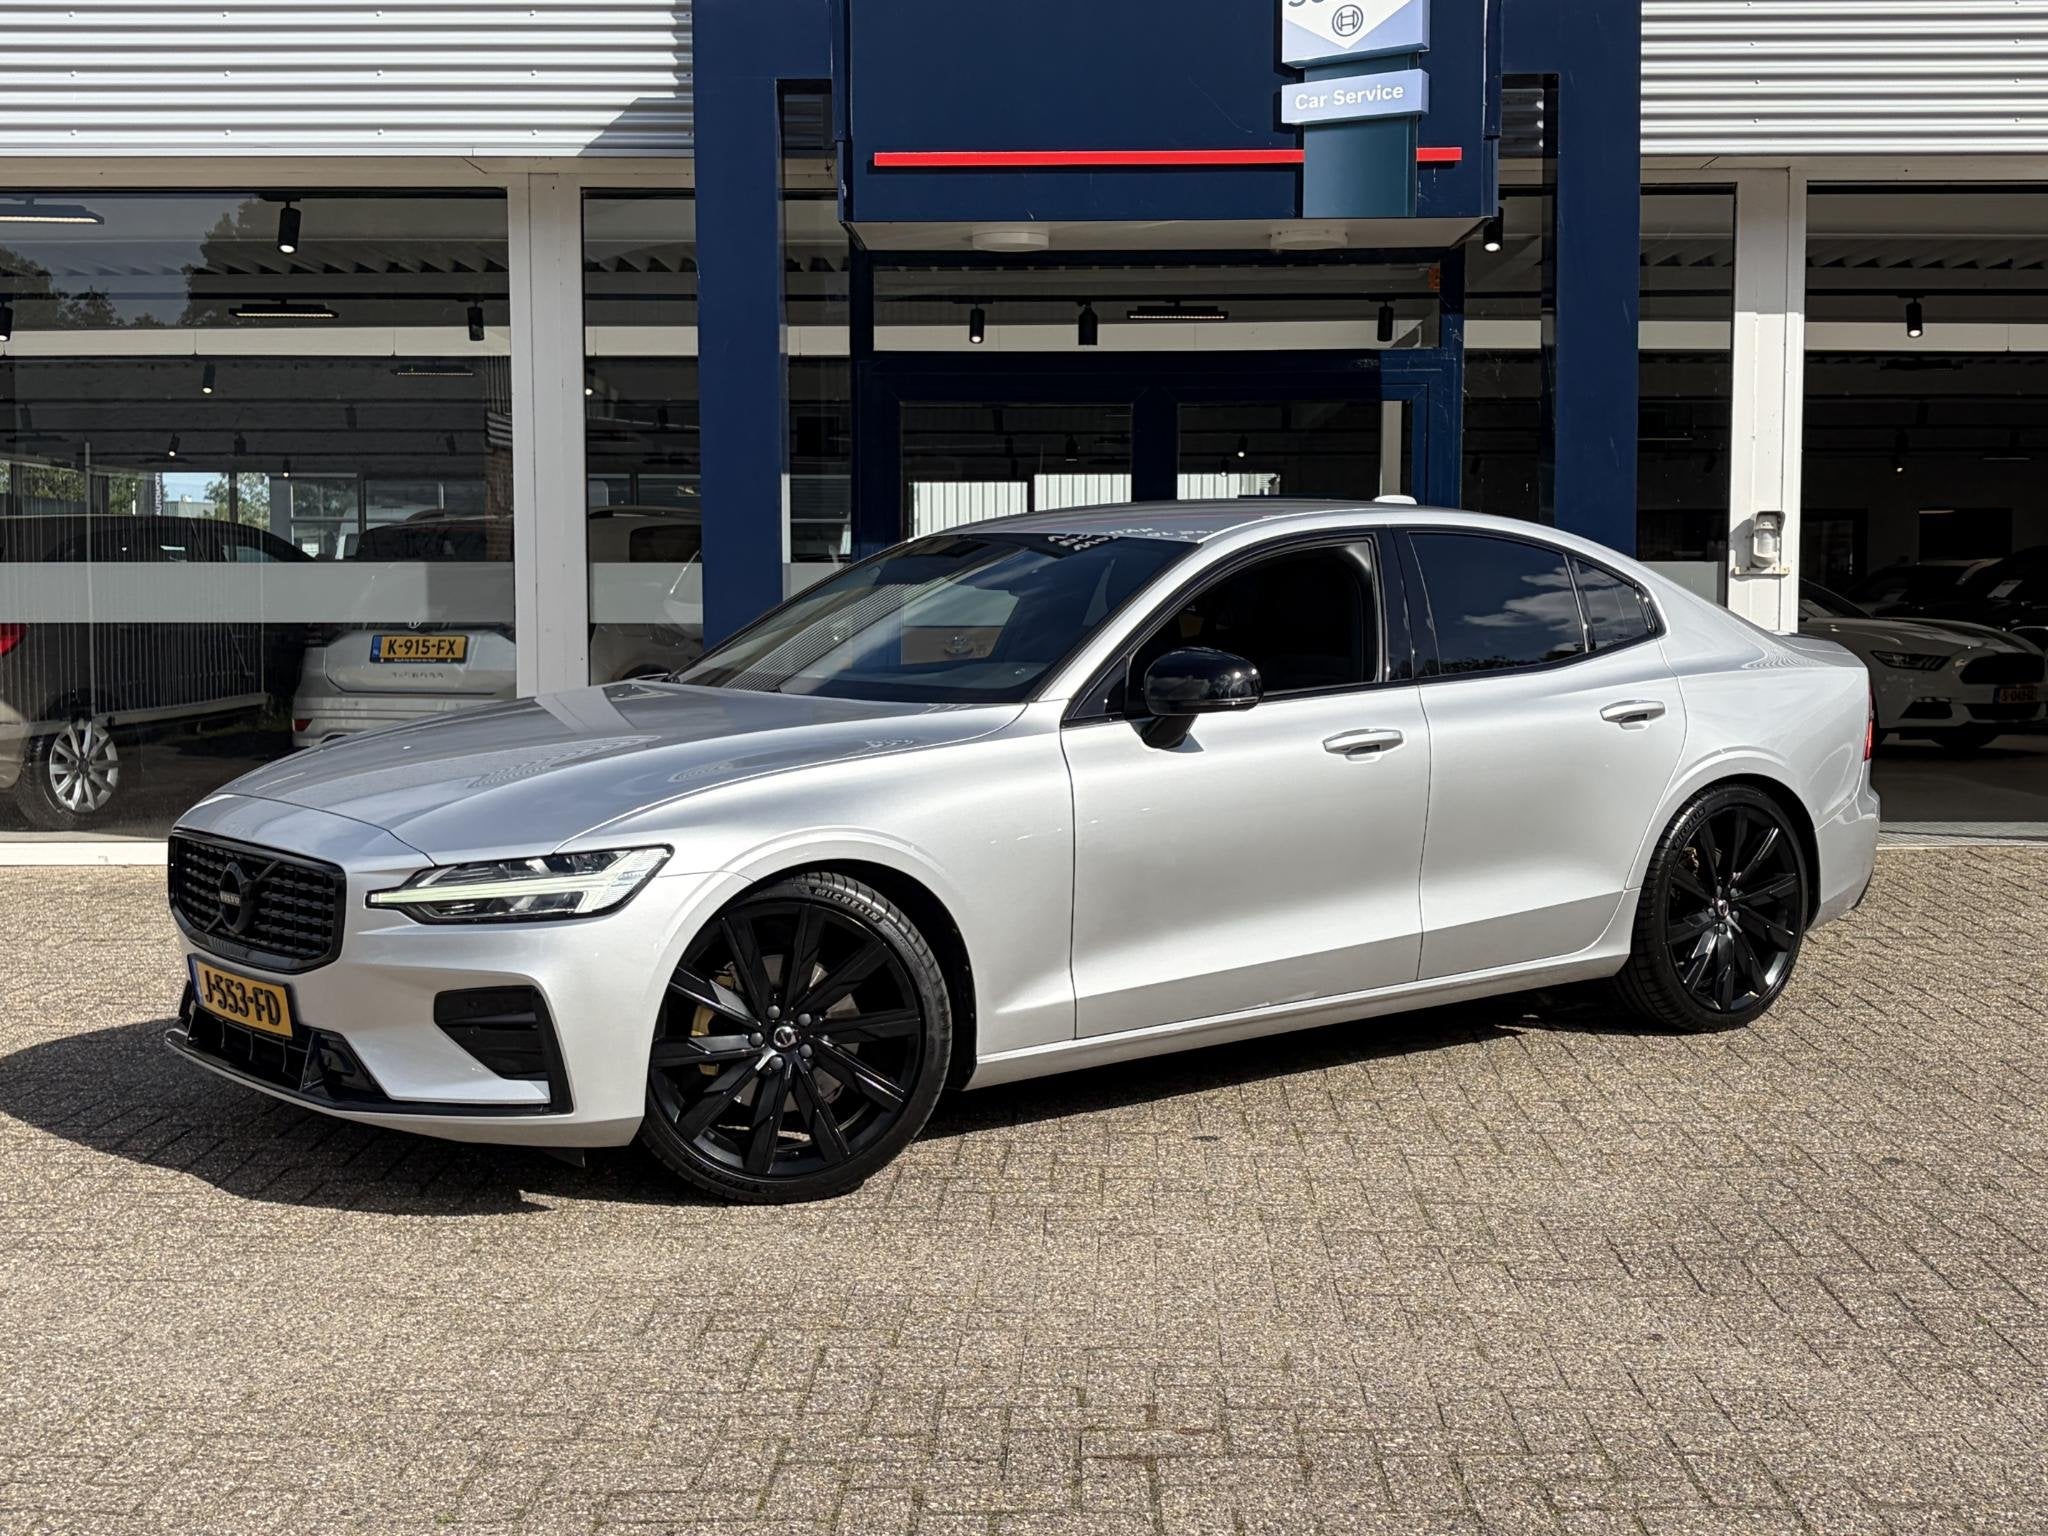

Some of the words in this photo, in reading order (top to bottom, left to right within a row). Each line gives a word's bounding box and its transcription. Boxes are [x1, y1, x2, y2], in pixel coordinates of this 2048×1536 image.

[1295, 93, 1328, 110] Car
[1333, 84, 1404, 106] Service
[387, 639, 456, 656] K-915-FX
[814, 887, 881, 921] MICHELIN
[204, 970, 281, 1026] J-553-FD
